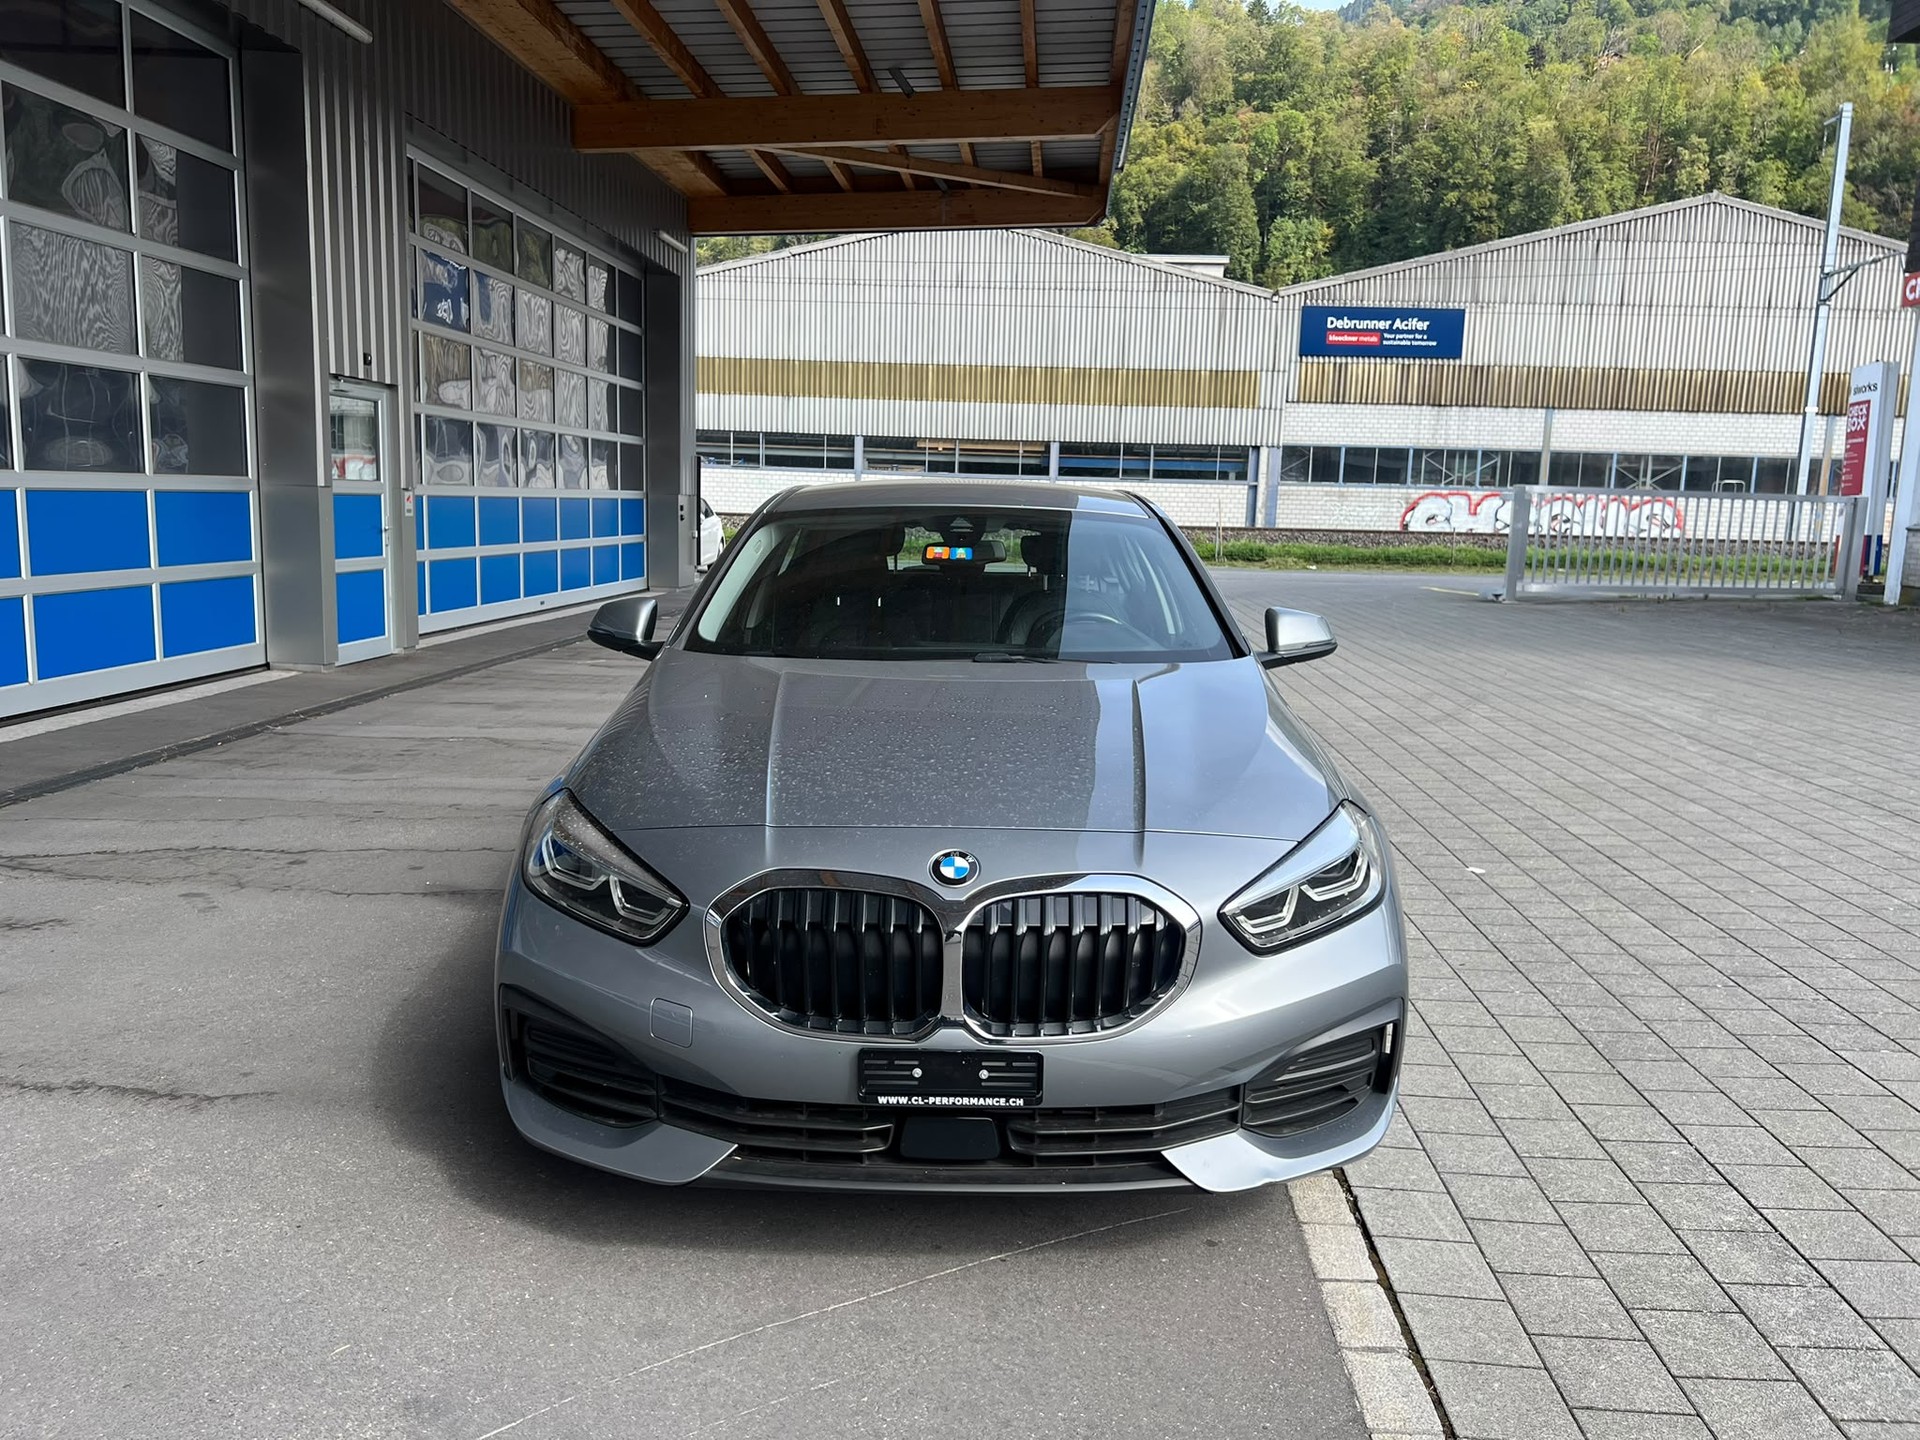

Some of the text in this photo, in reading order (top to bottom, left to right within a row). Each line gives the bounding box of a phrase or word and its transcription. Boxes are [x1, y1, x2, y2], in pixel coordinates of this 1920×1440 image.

[1327, 316, 1430, 331] Debrunner Acifer
[877, 1095, 1024, 1107] WWW.CL-PERFORMANCE.CH
